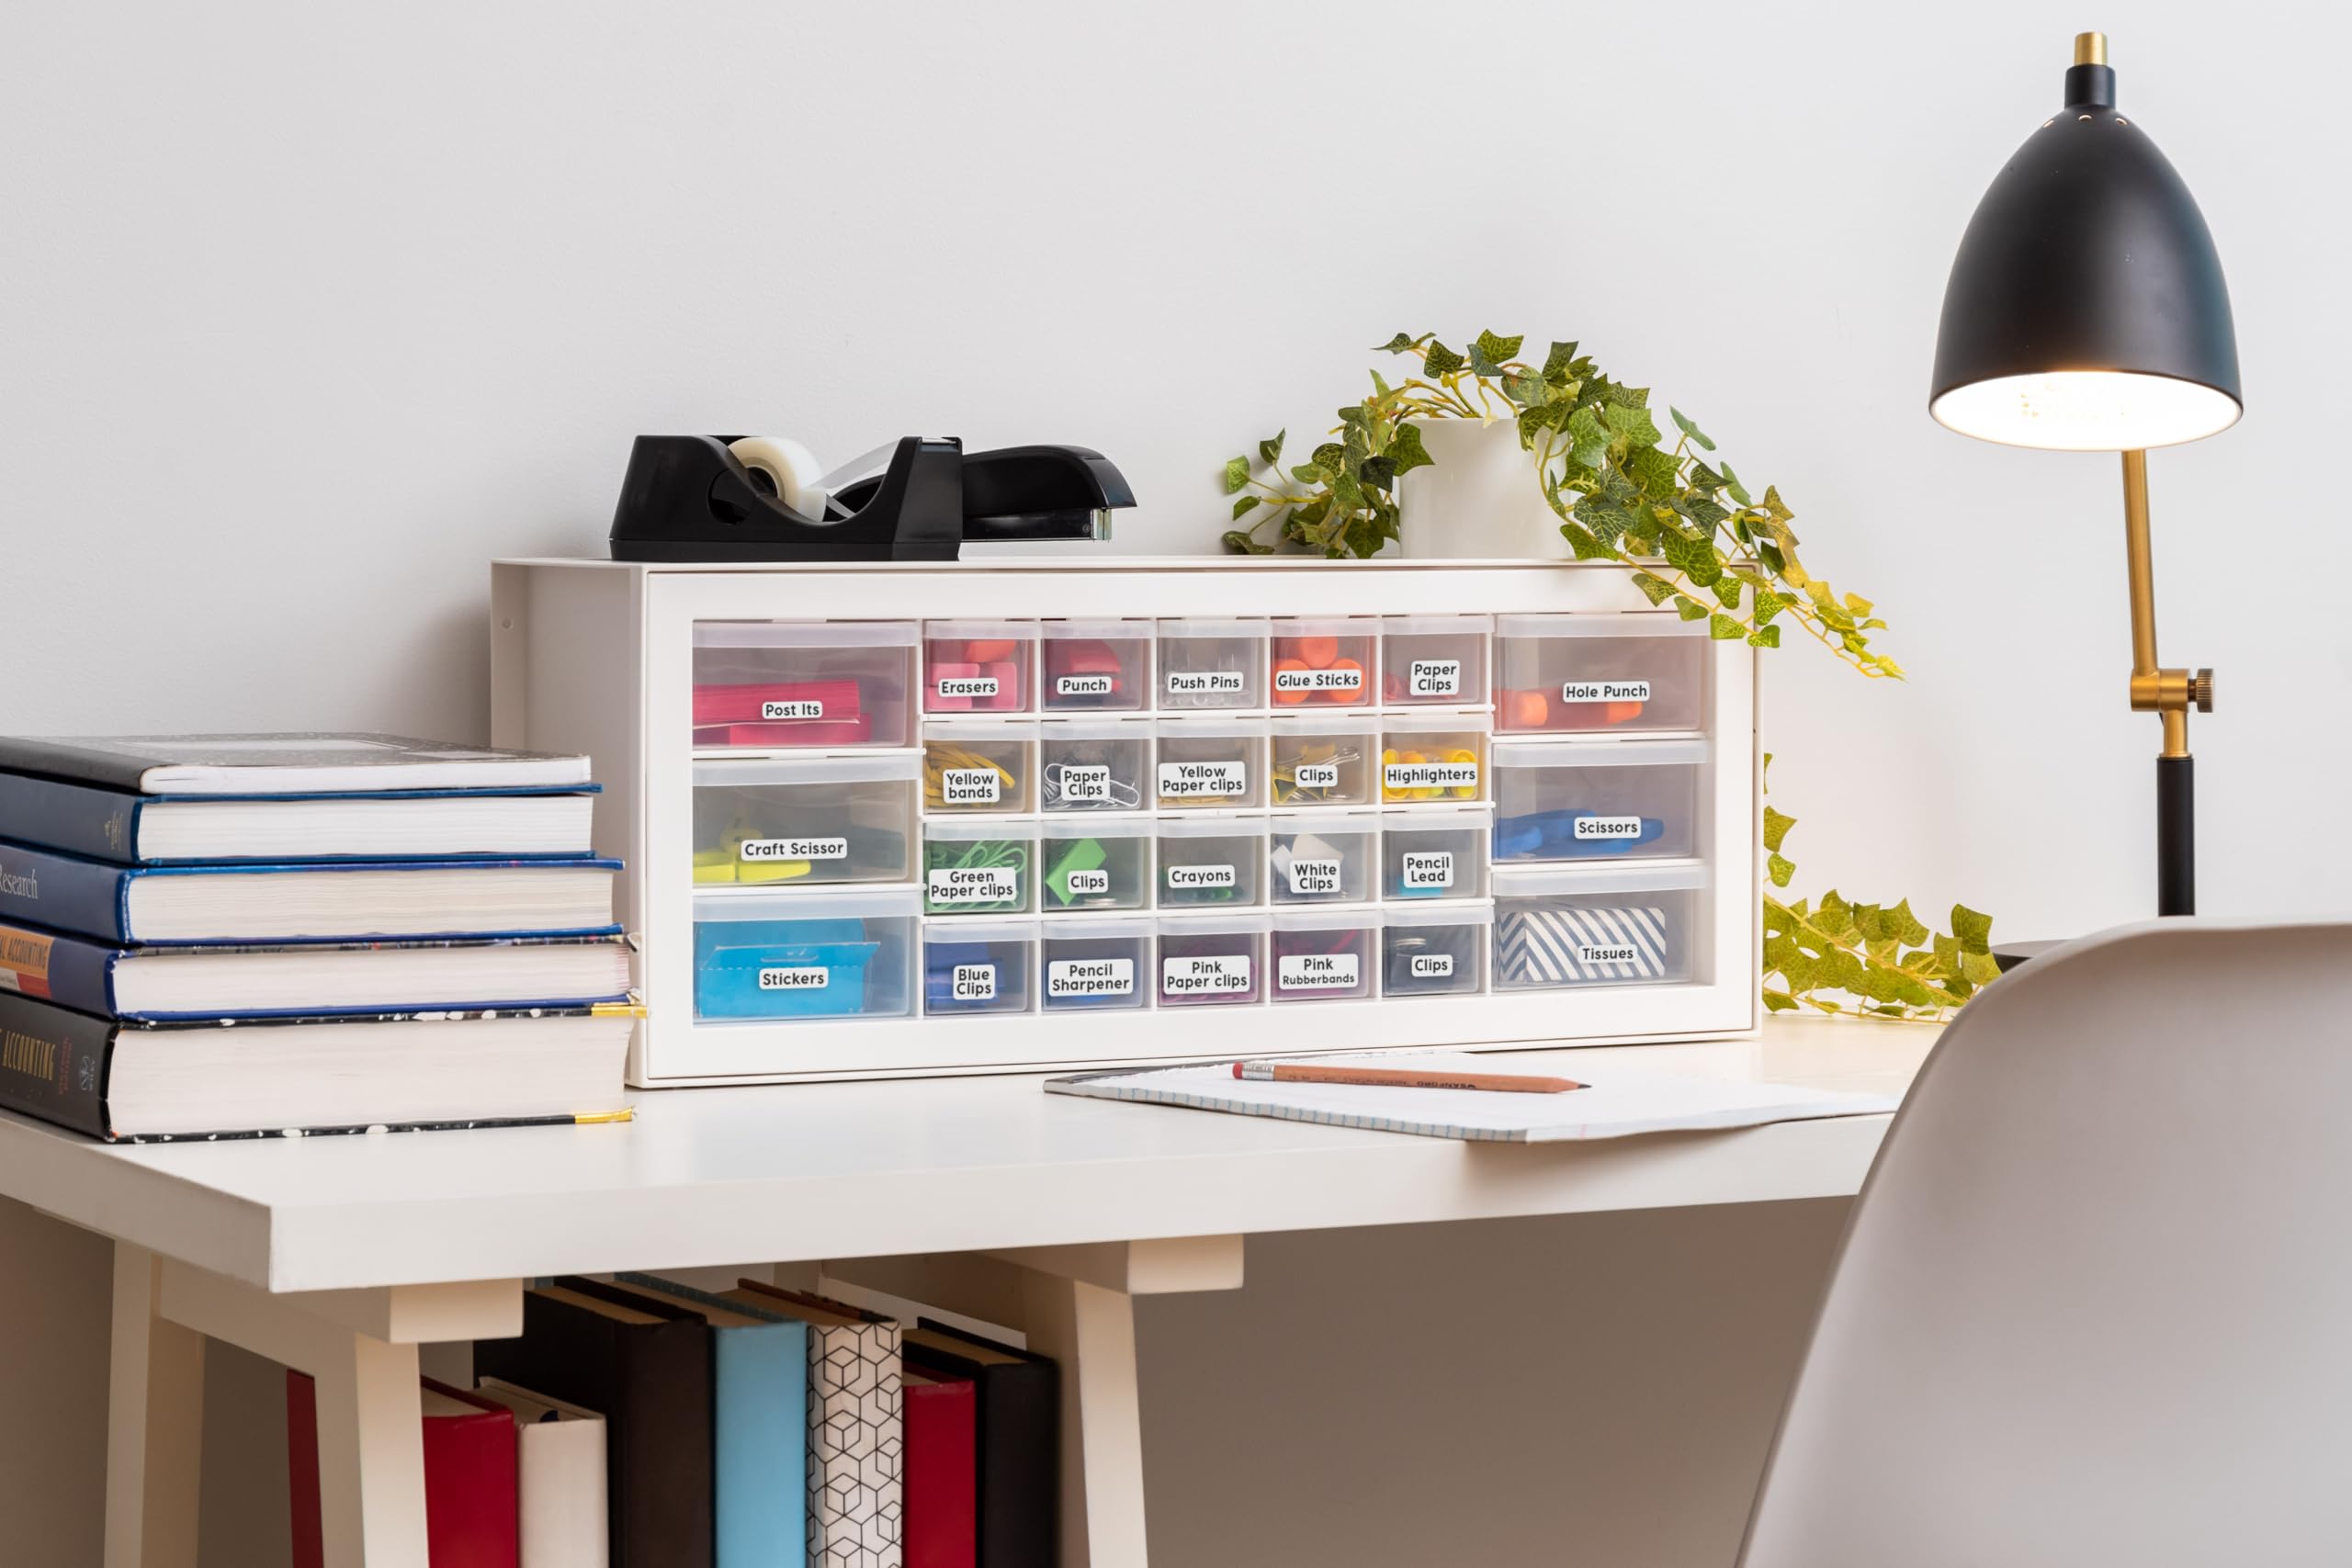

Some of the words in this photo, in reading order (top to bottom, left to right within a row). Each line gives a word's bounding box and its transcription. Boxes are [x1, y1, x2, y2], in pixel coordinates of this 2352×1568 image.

[1414, 663, 1457, 678] Paper
[1062, 679, 1107, 692] Punch
[1171, 676, 1205, 690] Push
[1210, 676, 1240, 689] Pins
[1278, 674, 1311, 687] Glue
[1316, 673, 1359, 686] Sticks
[1418, 678, 1452, 693] Clips
[942, 681, 996, 694] Erasers
[1566, 685, 1599, 698] Hole
[1603, 684, 1647, 697] Punch
[765, 704, 797, 717] Post
[801, 703, 820, 716] Its
[1064, 770, 1106, 784] Paper
[1179, 765, 1227, 778] Yellow
[1299, 769, 1334, 784] Clips
[1387, 768, 1476, 784] Highlighters
[946, 773, 994, 785] Yellow
[948, 785, 993, 799] bands
[1068, 783, 1103, 798] Clips
[1162, 779, 1205, 795] Paper
[1209, 778, 1243, 793] clips
[1578, 821, 1638, 834] Scissors
[744, 842, 785, 856] Craft
[790, 841, 844, 855] Scissor
[1295, 863, 1337, 876] White
[1407, 856, 1450, 870] Pencil
[949, 871, 994, 884] Green
[1070, 875, 1105, 890] Clips
[1171, 870, 1231, 885] Crayons
[1410, 870, 1445, 883] Lead
[931, 885, 975, 899] Paper
[979, 883, 1013, 898] clips
[1299, 877, 1333, 892] Clips
[1582, 947, 1634, 960] Tissues
[1069, 964, 1113, 977] Pencil
[1192, 961, 1222, 974] Pink
[1304, 957, 1333, 971] Pink
[1414, 958, 1448, 974] Clips
[763, 972, 824, 986] Stickers
[958, 968, 989, 981] Blue
[1283, 974, 1354, 985] Rubberbands
[1052, 978, 1130, 993] Sharpener
[1167, 976, 1210, 991] Paper
[1215, 974, 1248, 989] clips
[956, 982, 991, 998] Clips
[2, 1030, 56, 1081] ACCOUNTING
